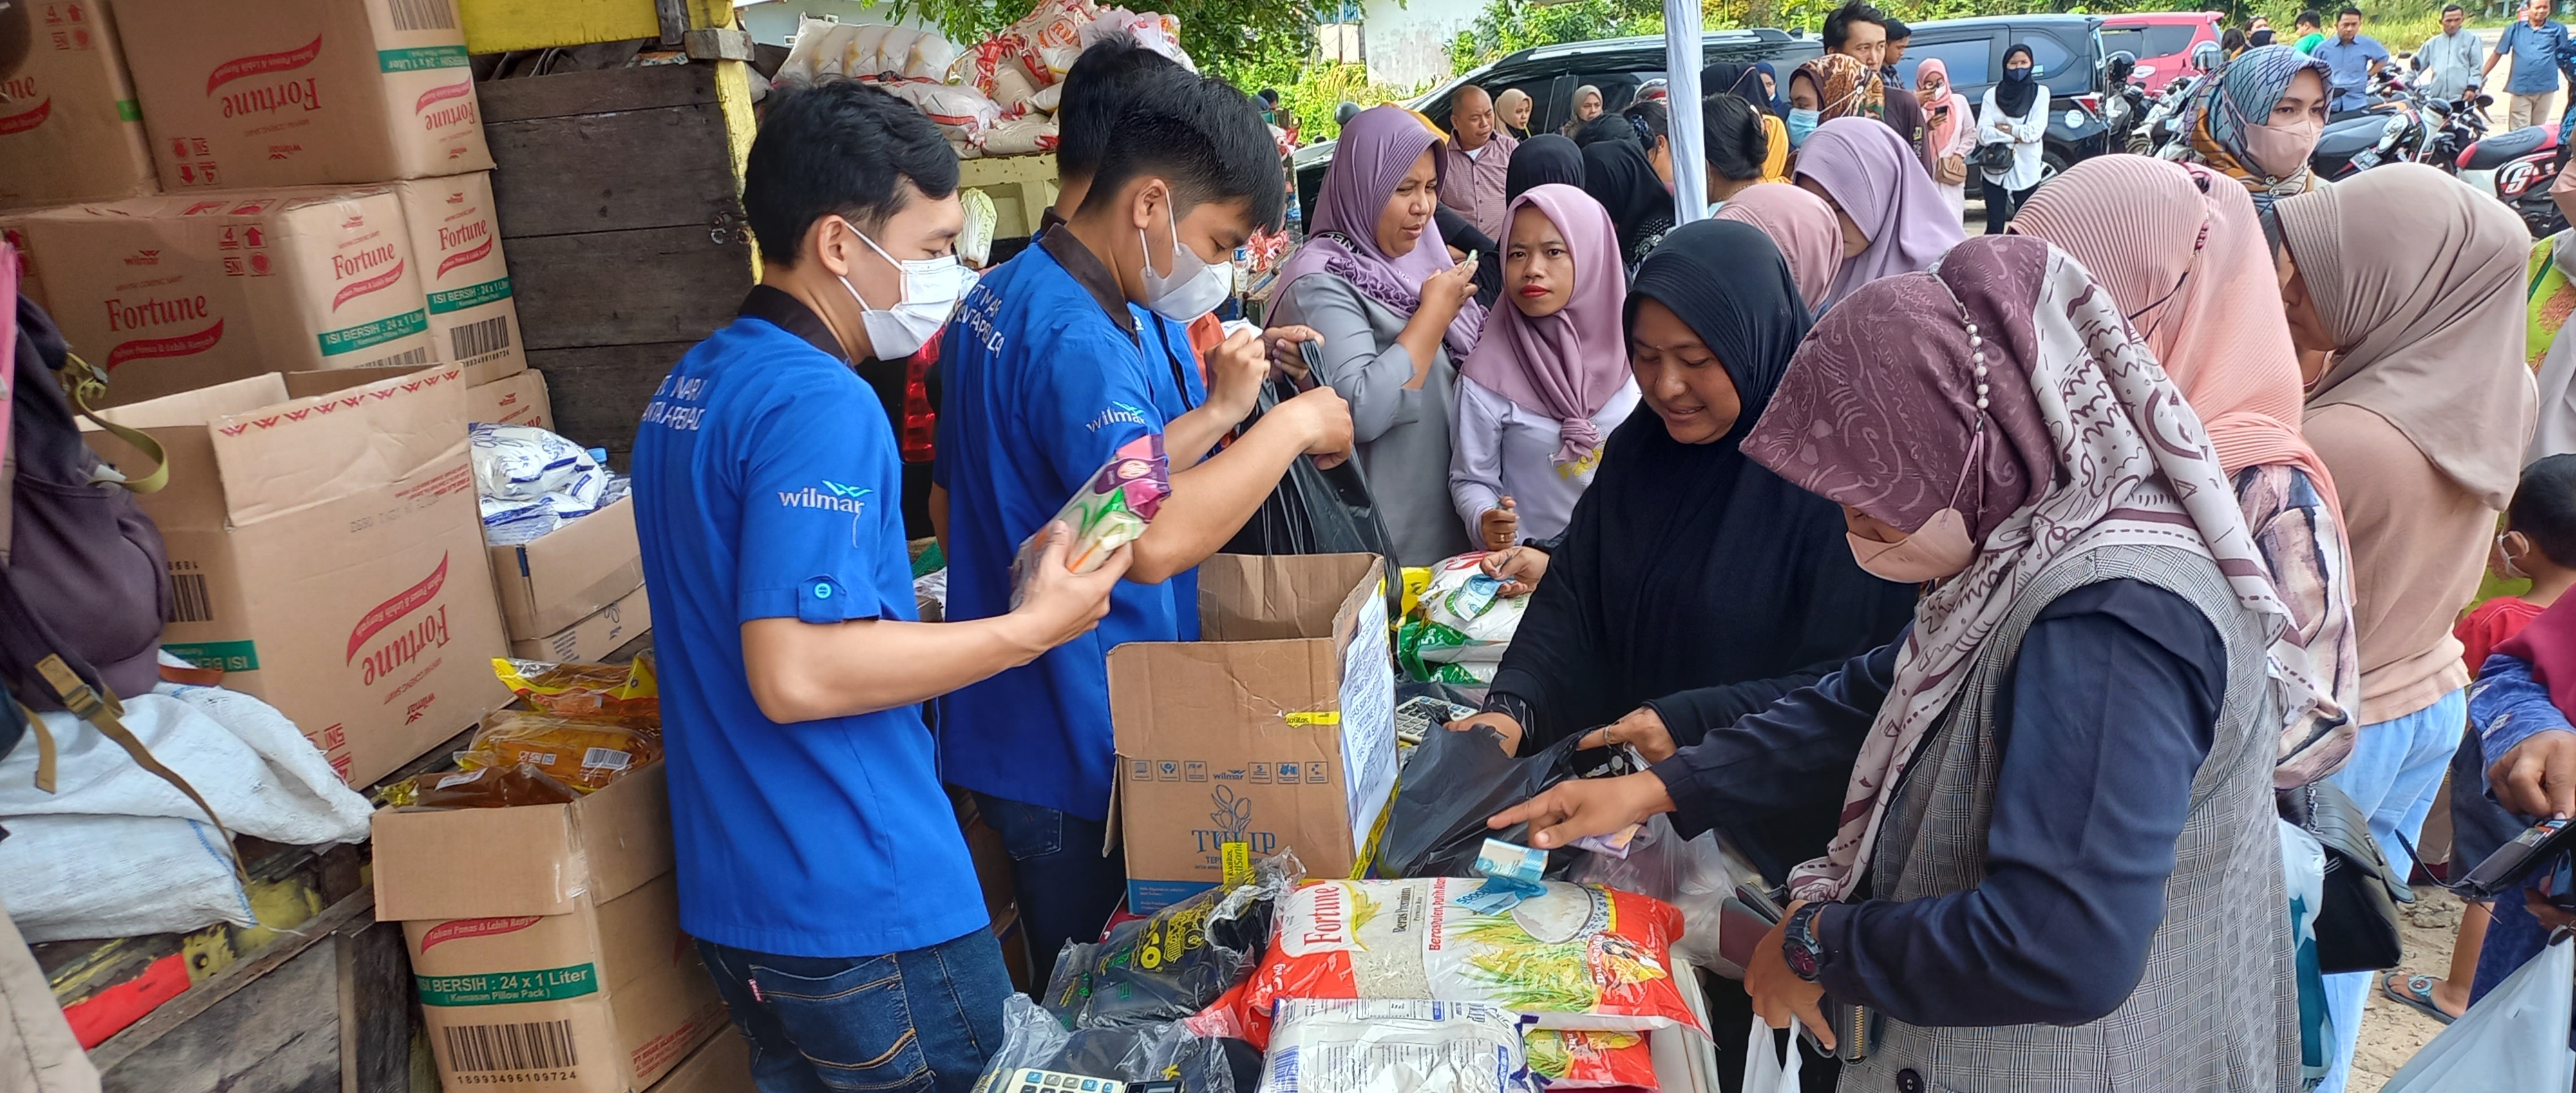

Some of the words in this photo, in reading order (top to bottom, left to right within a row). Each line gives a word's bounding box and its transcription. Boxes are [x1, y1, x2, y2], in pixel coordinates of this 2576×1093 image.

[222, 77, 321, 119] Fortune
[425, 101, 476, 131] Fortune
[437, 218, 488, 251] Fortune
[331, 243, 395, 281] Fortune
[433, 293, 446, 305] ISI
[448, 287, 477, 301] BERSIH
[104, 295, 209, 332] Fortune
[325, 332, 341, 345] ISI
[343, 324, 381, 342] BERSIH
[1085, 406, 1146, 433] wilmar
[778, 486, 866, 514] wilmar
[362, 604, 450, 686] Fortune
[1213, 772, 1244, 781] wilmar
[1303, 886, 1343, 946] Fortune
[432, 977, 488, 993] BERSIH
[500, 975, 518, 989] 24
[522, 976, 532, 988] x
[535, 974, 545, 986] 1
[548, 968, 589, 985] Liter
[521, 987, 545, 998] Pack
